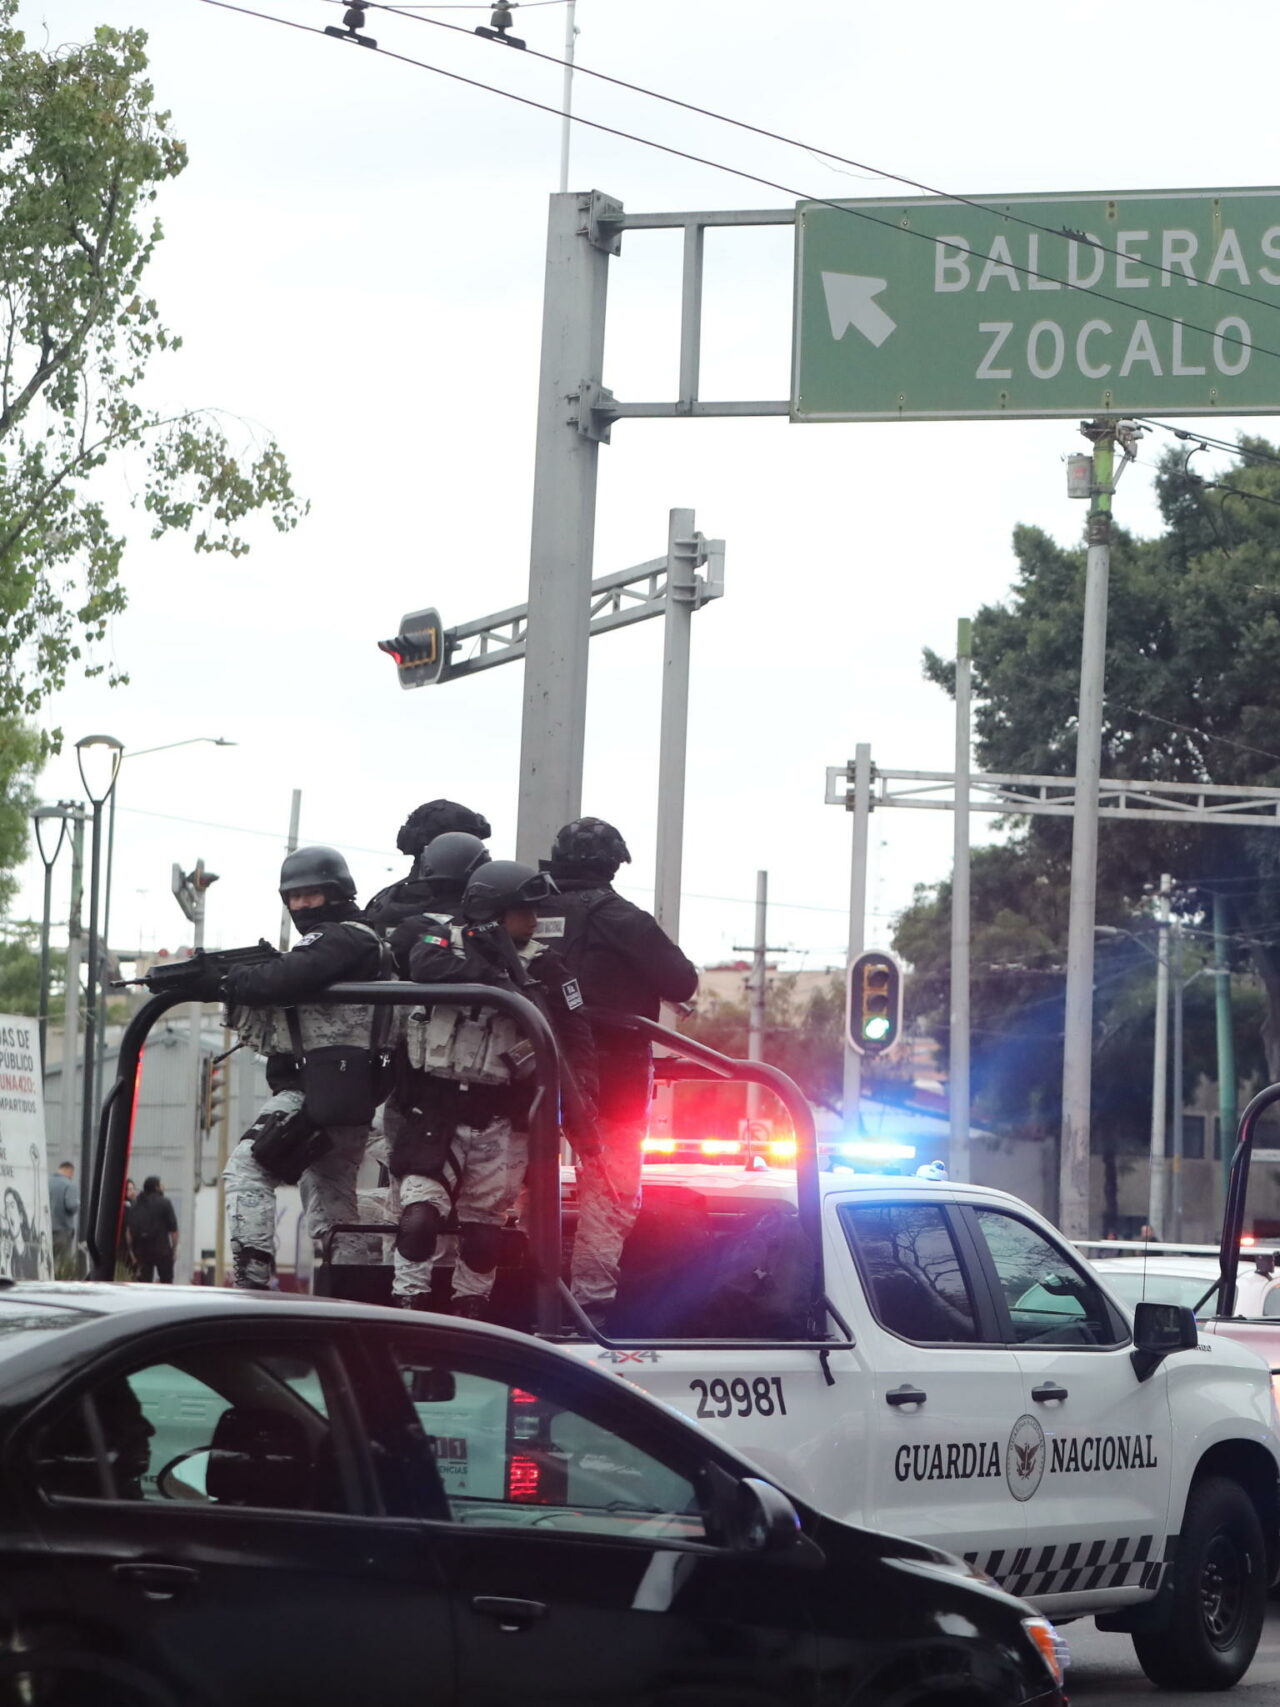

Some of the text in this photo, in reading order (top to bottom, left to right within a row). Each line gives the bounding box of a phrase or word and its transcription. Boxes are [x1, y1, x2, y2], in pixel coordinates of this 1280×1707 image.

[974, 316, 1253, 380] ZOCALO
[17, 1029, 30, 1049] DE
[689, 1377, 787, 1418] 29981
[894, 1442, 1001, 1482] GUARDIA
[1050, 1434, 1158, 1473] NACIONAL
